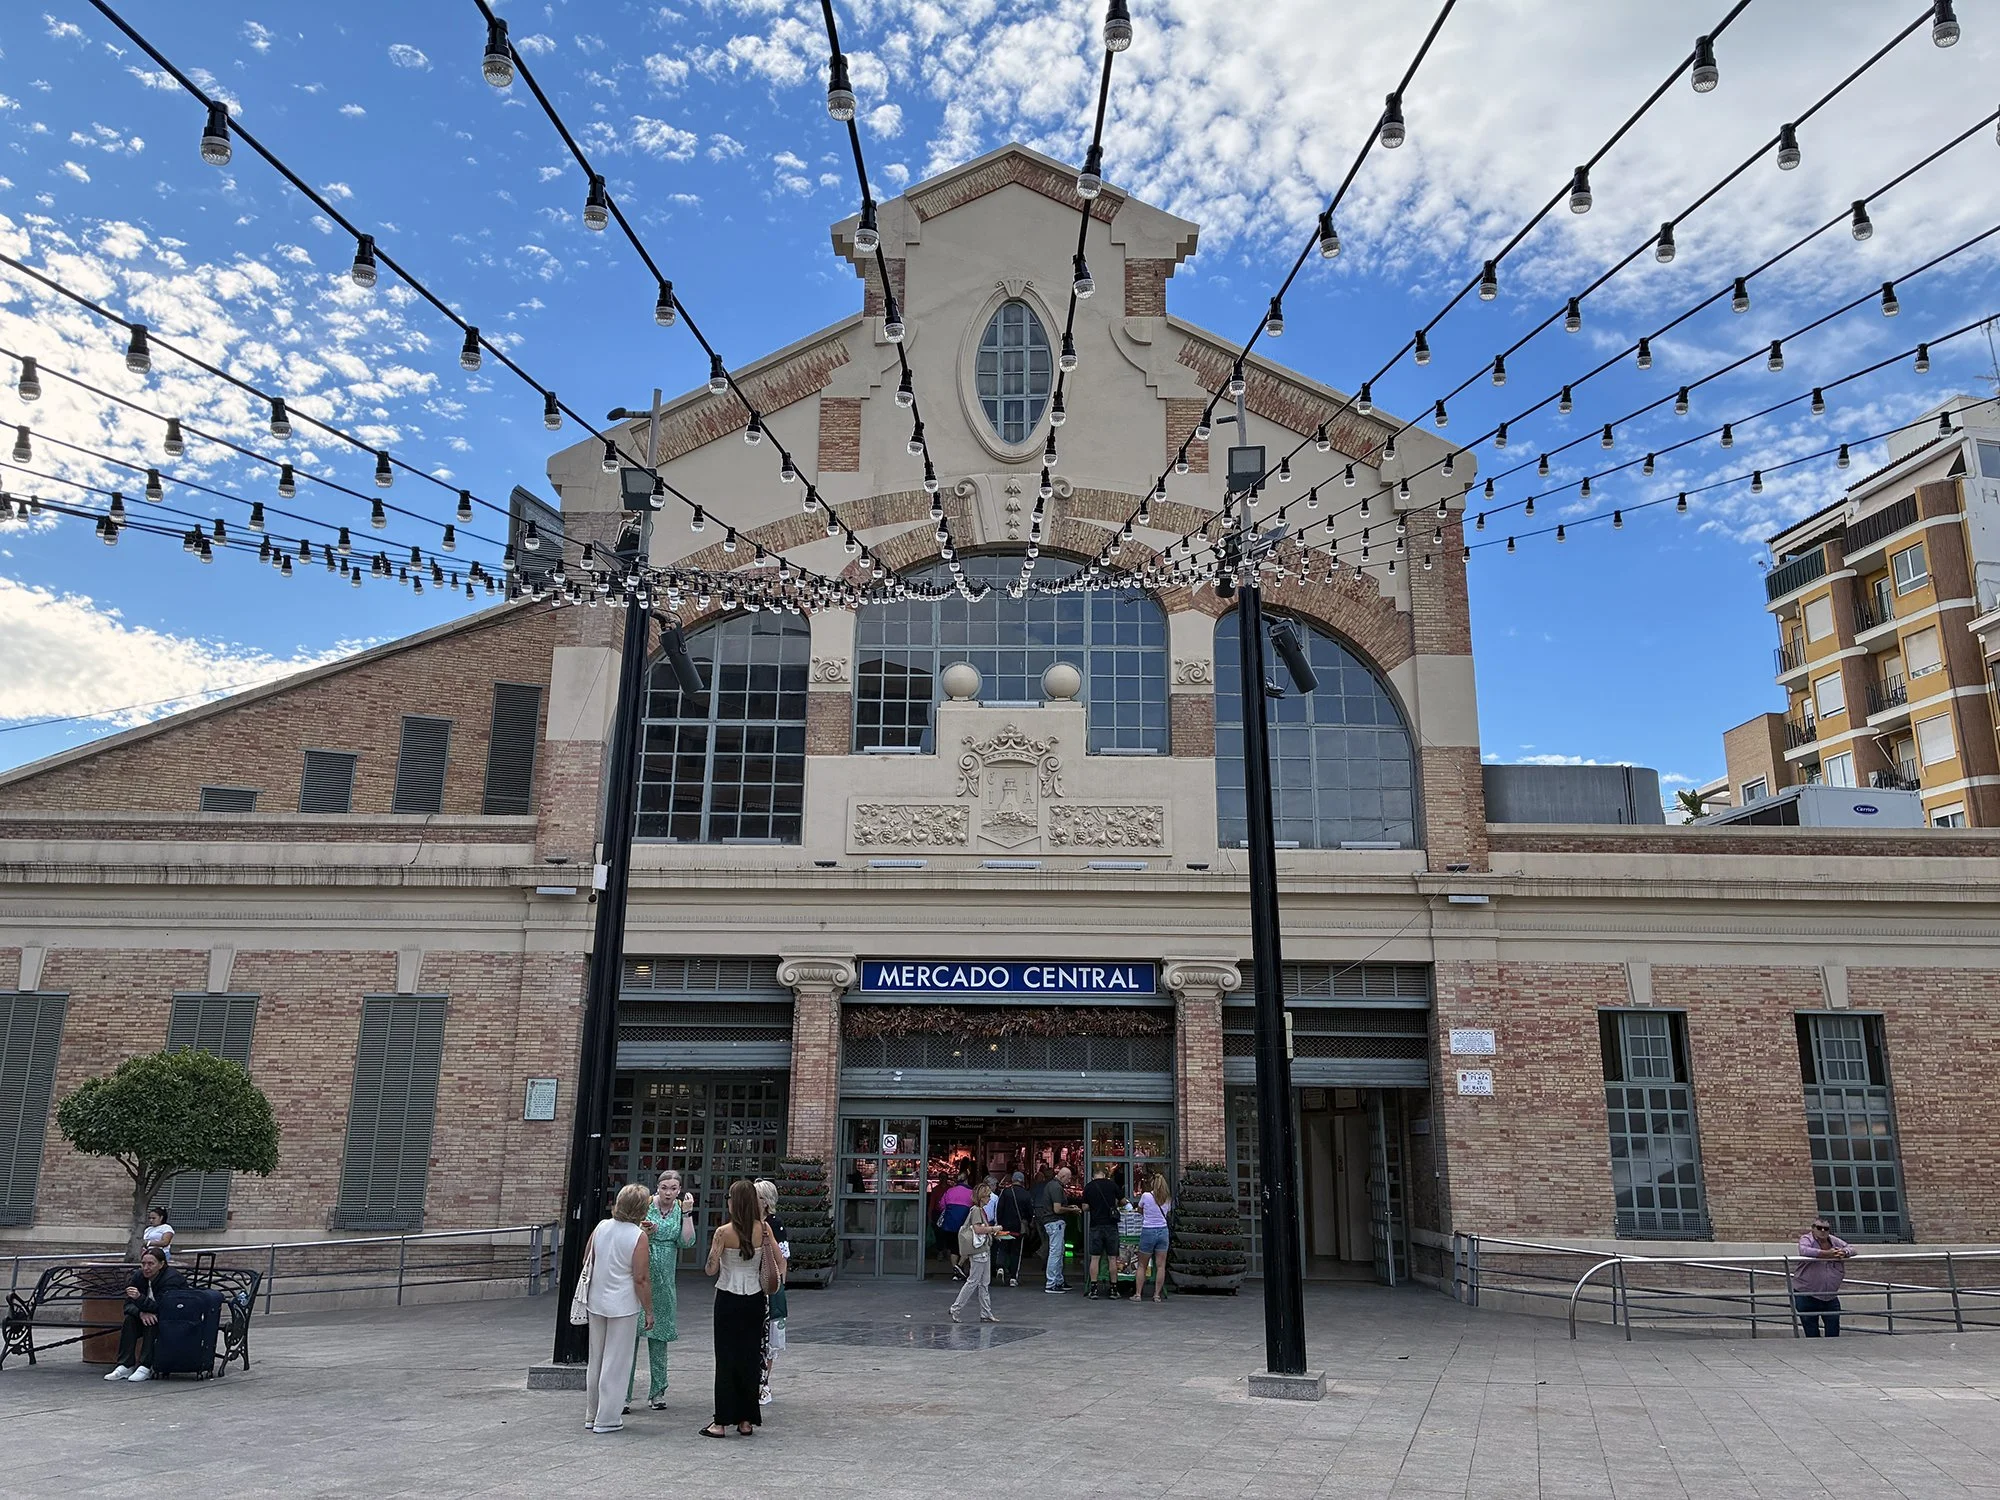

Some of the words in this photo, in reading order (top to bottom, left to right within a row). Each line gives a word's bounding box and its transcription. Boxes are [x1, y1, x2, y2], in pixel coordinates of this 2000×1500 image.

[1023, 790, 1034, 804] A
[877, 965, 1010, 988] MERCADO
[1023, 966, 1139, 989] CENTRAL
